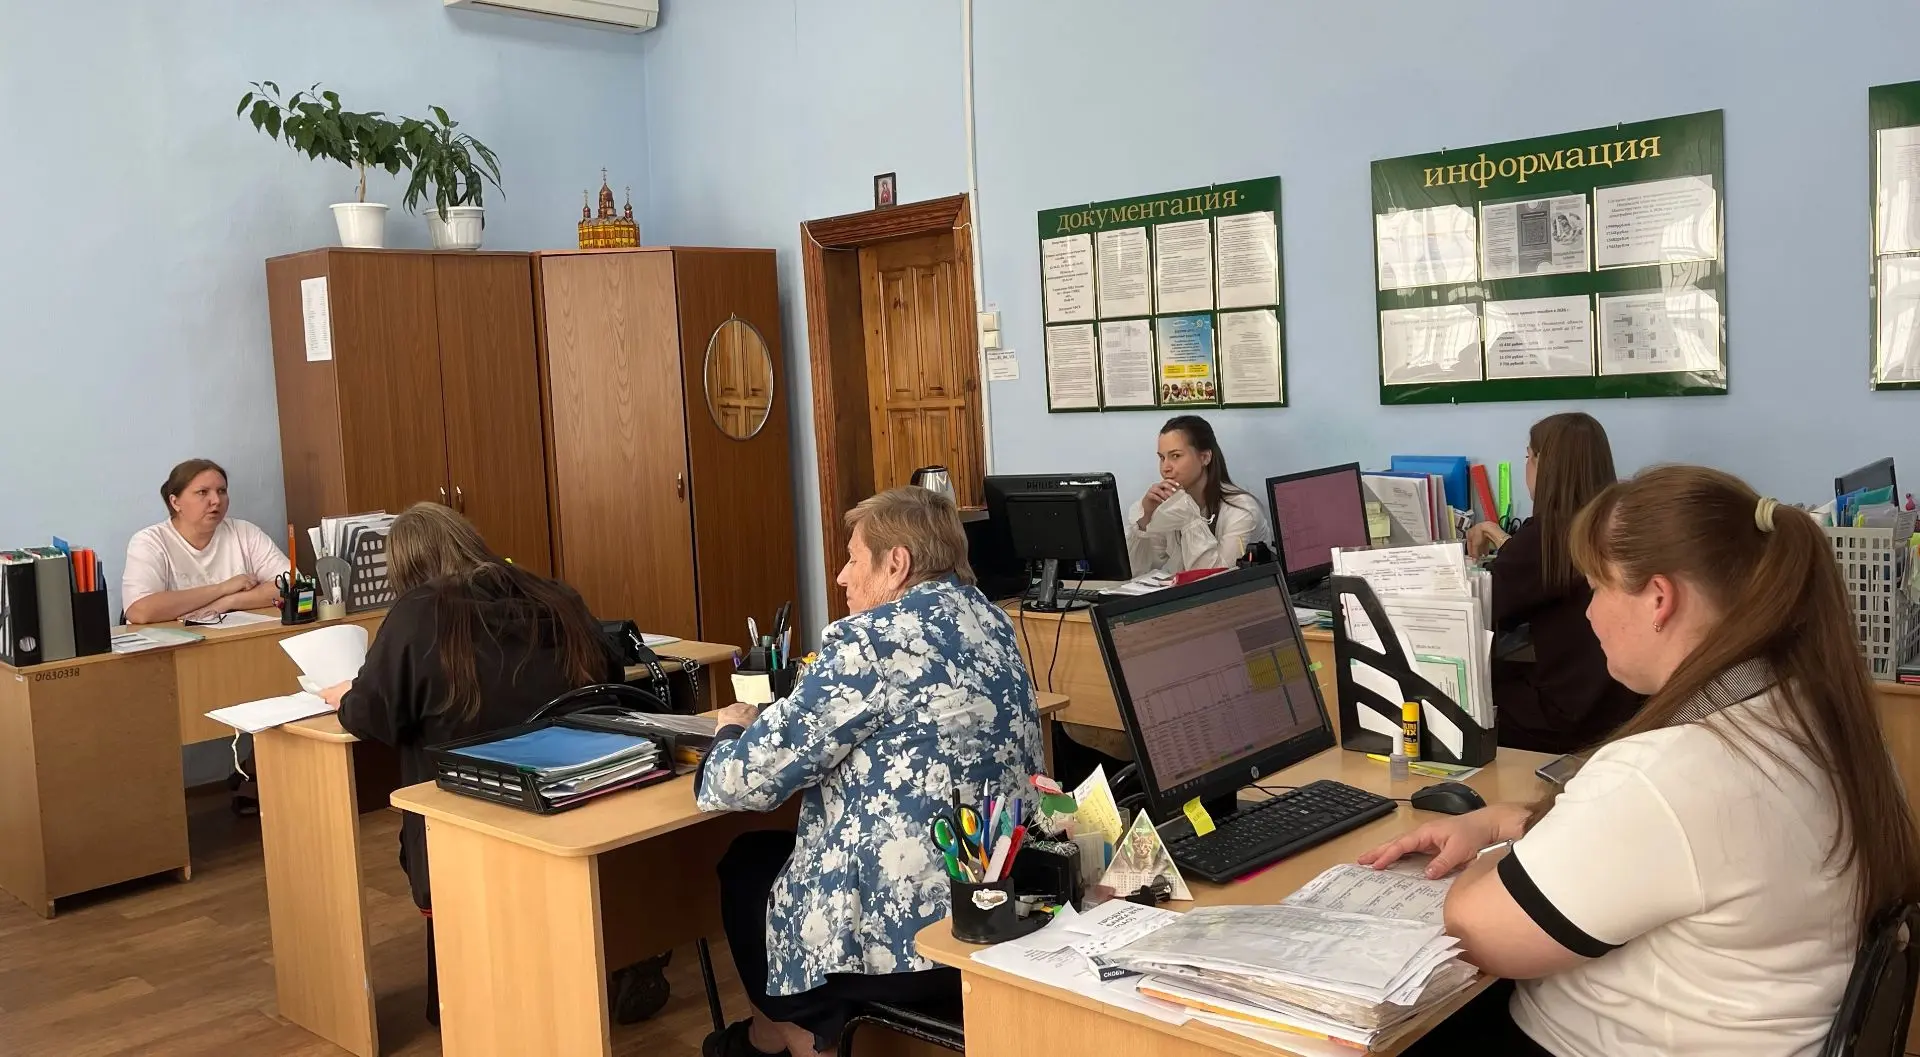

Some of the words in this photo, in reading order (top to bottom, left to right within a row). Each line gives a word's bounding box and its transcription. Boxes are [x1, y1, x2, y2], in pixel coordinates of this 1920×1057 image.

[1424, 135, 1662, 189] информация
[1056, 189, 1238, 233] документация
[35, 667, 80, 682] 01630338
[1103, 969, 1125, 978] СКОБЫ
